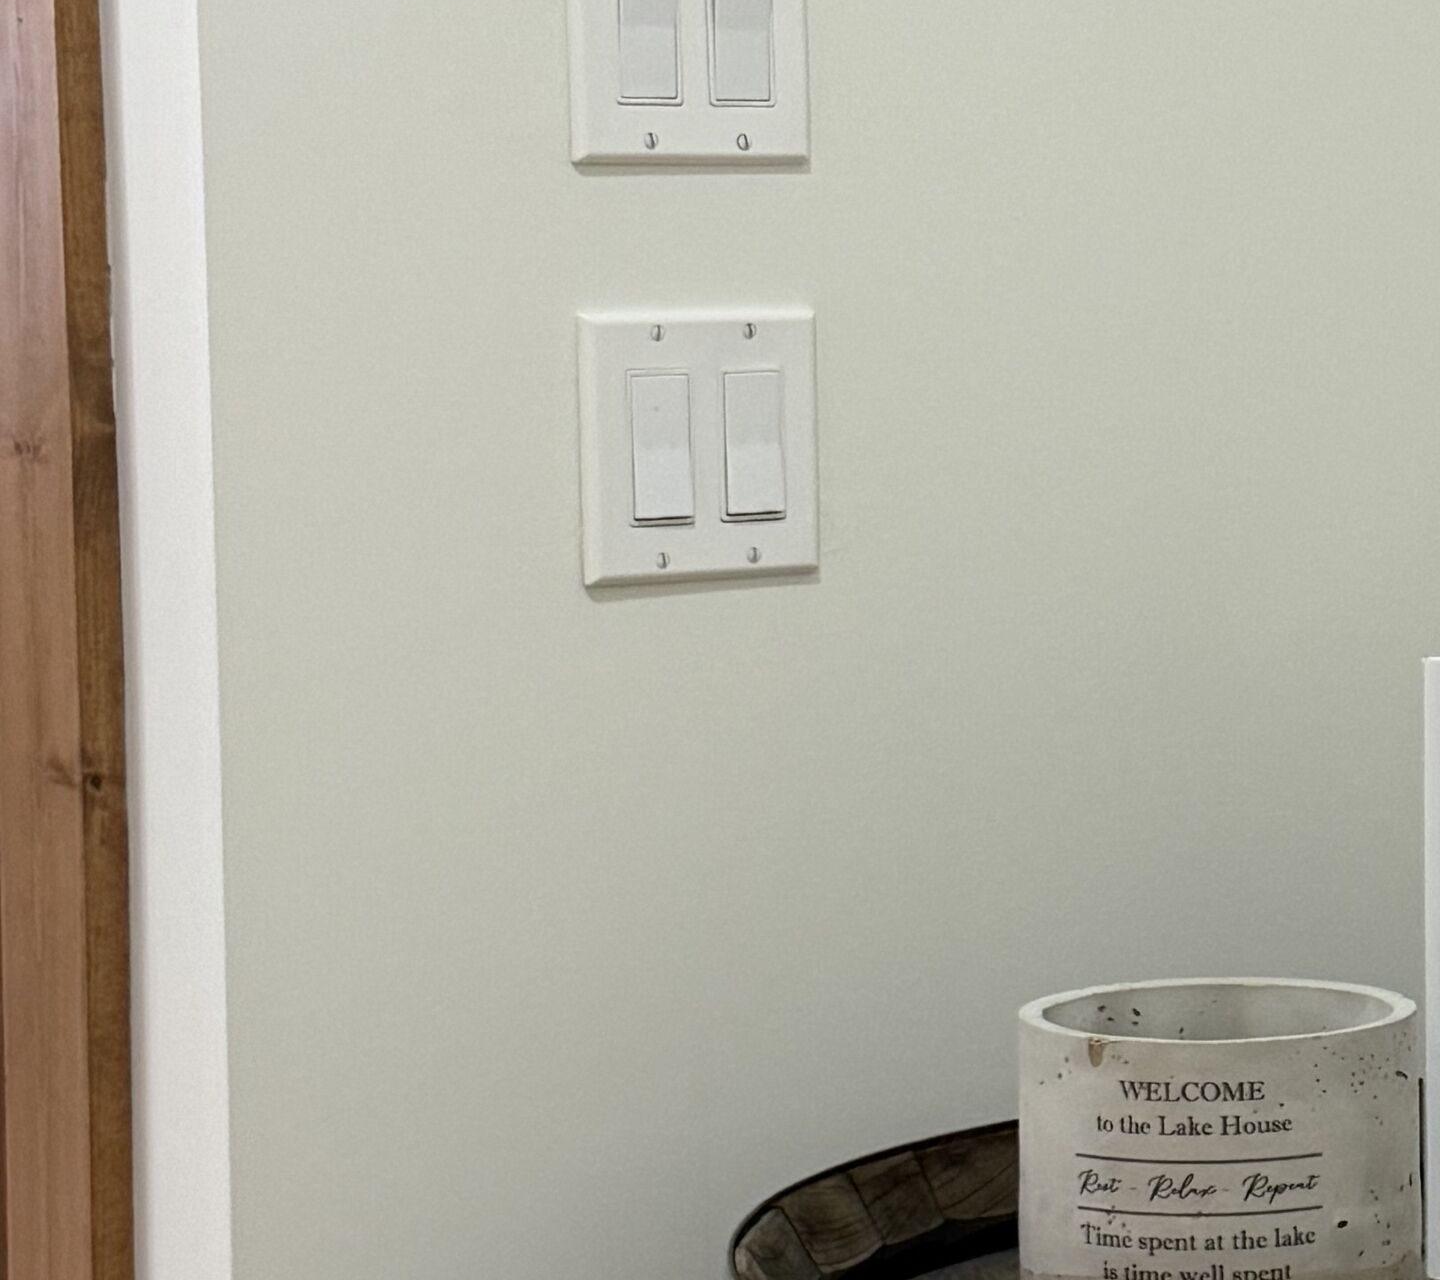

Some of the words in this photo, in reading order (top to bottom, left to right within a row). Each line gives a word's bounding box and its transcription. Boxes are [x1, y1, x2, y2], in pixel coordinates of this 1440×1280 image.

[1119, 1080, 1265, 1102] WELCOME
[1097, 1115, 1114, 1133] to
[1120, 1115, 1151, 1135] the
[1157, 1115, 1213, 1136] Lake
[1219, 1114, 1293, 1136] House
[1078, 1168, 1122, 1195] Rest
[1148, 1173, 1217, 1202] Relax
[1242, 1172, 1321, 1205] Repeat
[1080, 1221, 1133, 1249] Time
[1138, 1234, 1198, 1256] spent
[1204, 1235, 1224, 1251] at
[1232, 1230, 1268, 1250] the
[1274, 1226, 1316, 1248] lake
[1103, 1260, 1118, 1280] is
